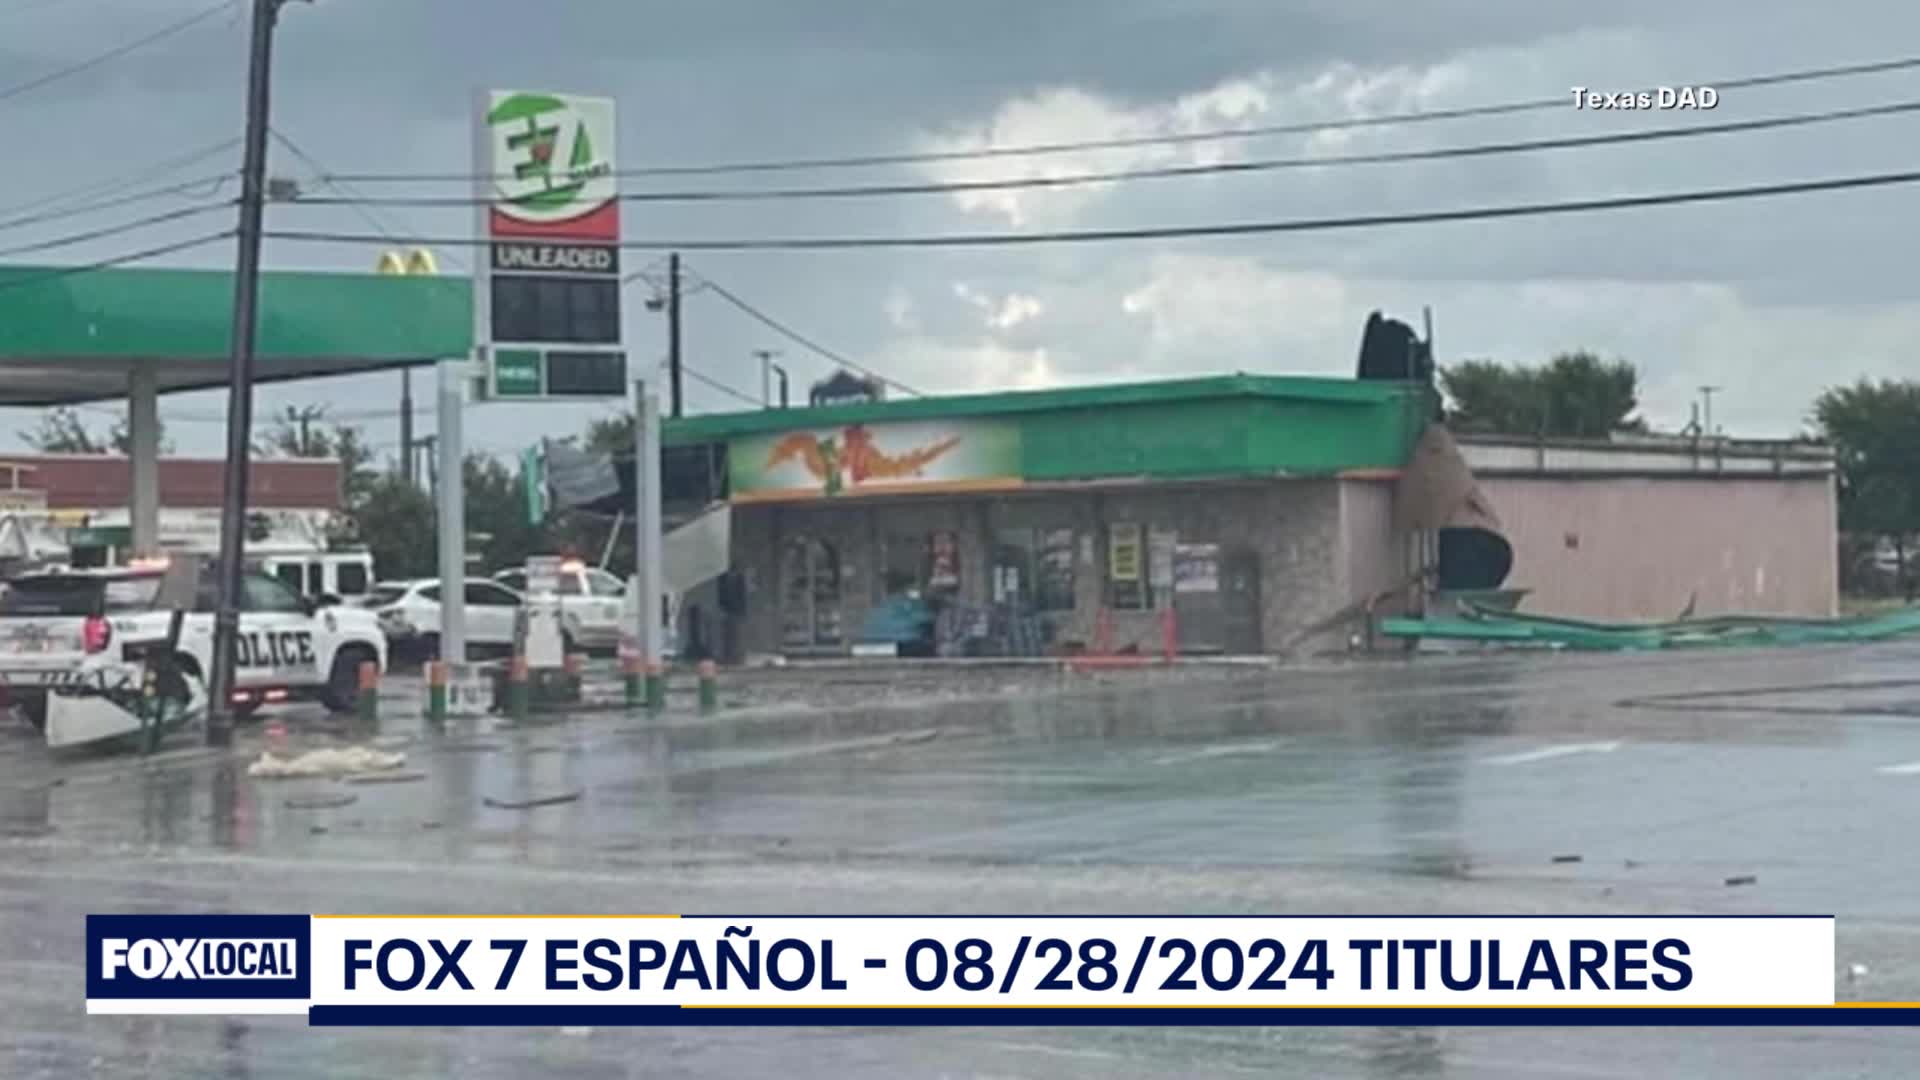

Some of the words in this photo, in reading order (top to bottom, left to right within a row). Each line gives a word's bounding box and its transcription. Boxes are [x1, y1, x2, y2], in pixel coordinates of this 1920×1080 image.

[494, 108, 592, 198] EZ
[498, 244, 611, 269] UNLEADED
[233, 630, 315, 667] OLICE
